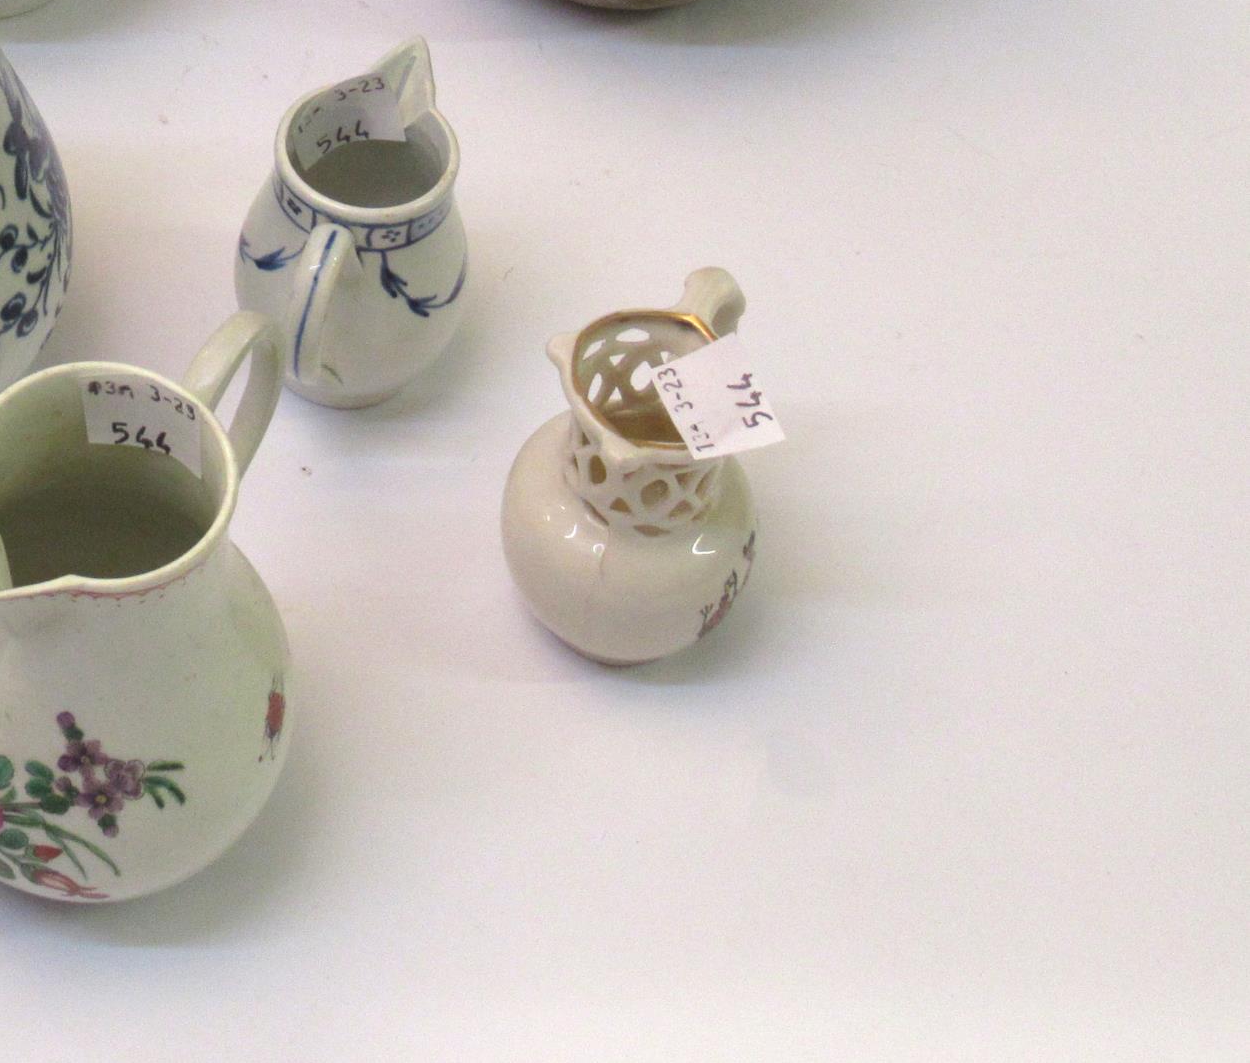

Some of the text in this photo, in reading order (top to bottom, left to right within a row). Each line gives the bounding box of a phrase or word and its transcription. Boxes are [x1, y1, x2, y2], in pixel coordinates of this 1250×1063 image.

[334, 77, 385, 101] 3-23
[316, 120, 369, 154] 544
[149, 384, 196, 420] 3-23
[657, 367, 694, 413] 3-23
[726, 372, 773, 428] 544
[112, 422, 171, 455] 544
